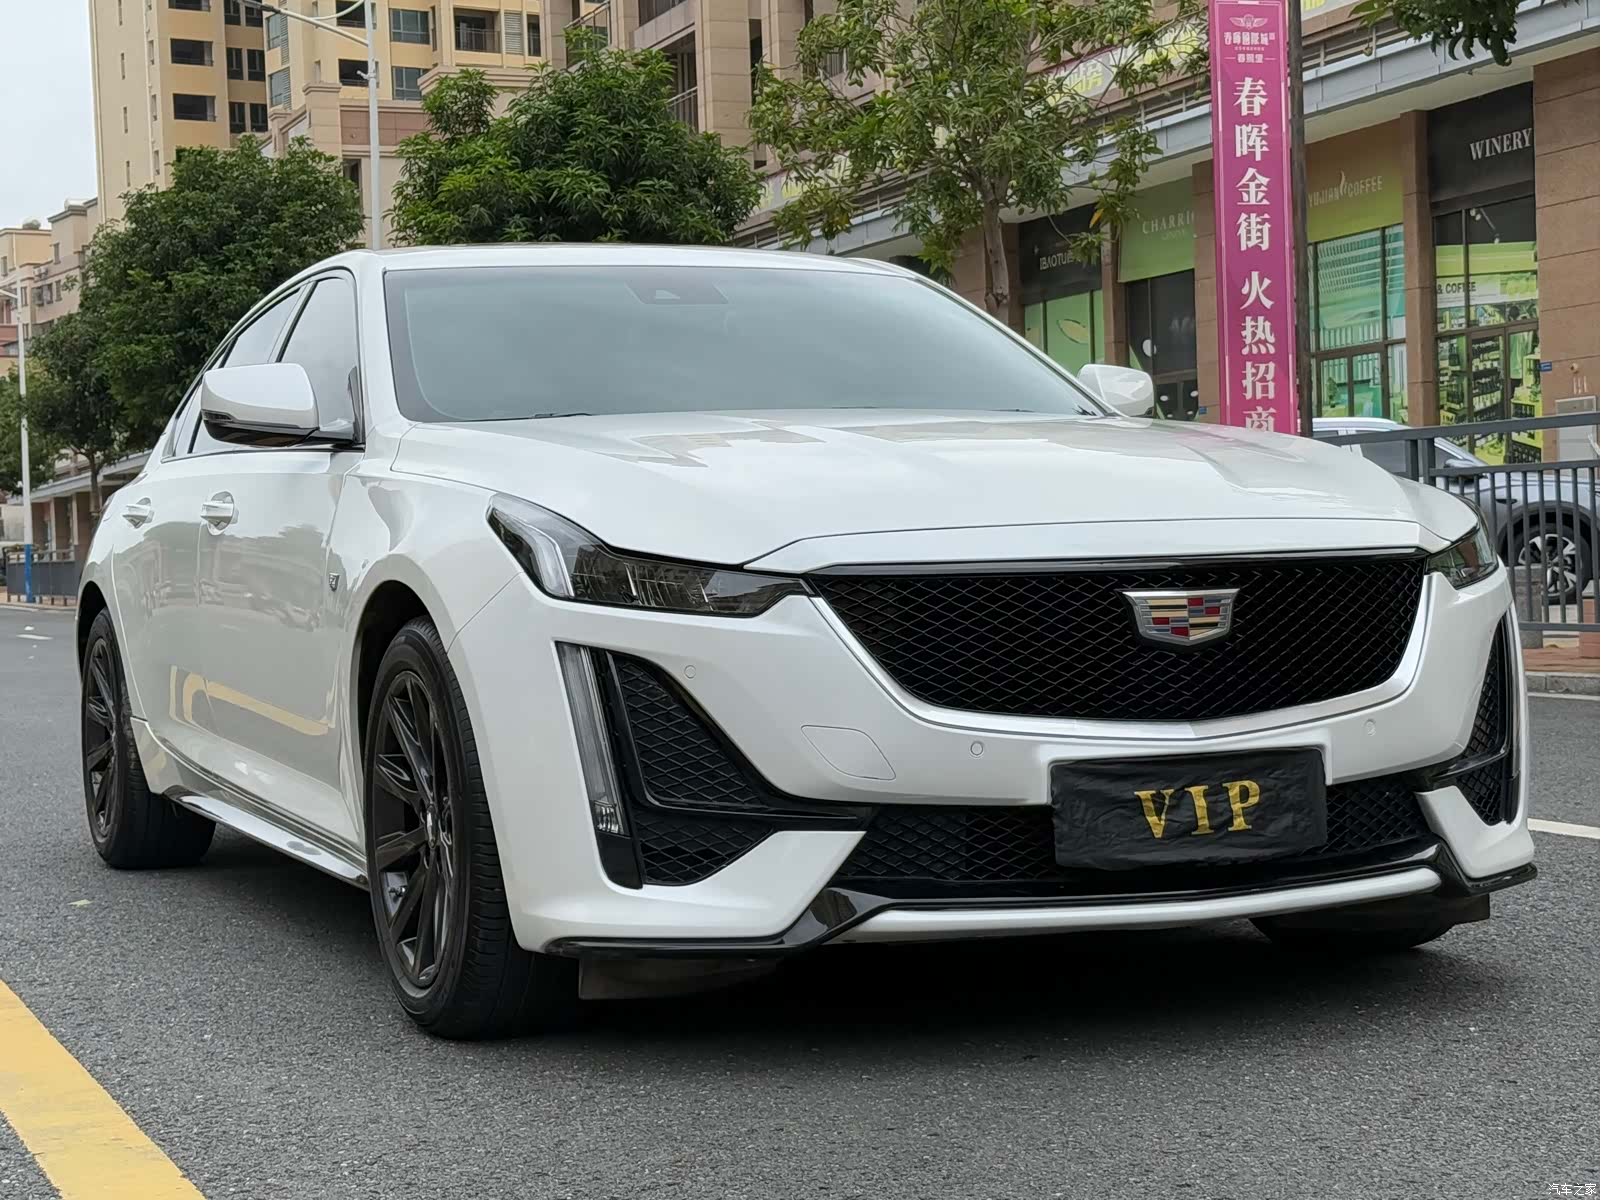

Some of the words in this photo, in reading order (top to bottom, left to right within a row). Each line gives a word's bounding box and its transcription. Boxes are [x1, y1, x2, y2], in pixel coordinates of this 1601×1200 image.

[1233, 77, 1271, 252] 春晖金街
[1469, 127, 1533, 161] WINERY
[1308, 186, 1339, 208] YUJIAN
[1347, 175, 1383, 198] COFFEE
[1240, 271, 1277, 432] 火热招商
[1134, 779, 1260, 838] VIP
